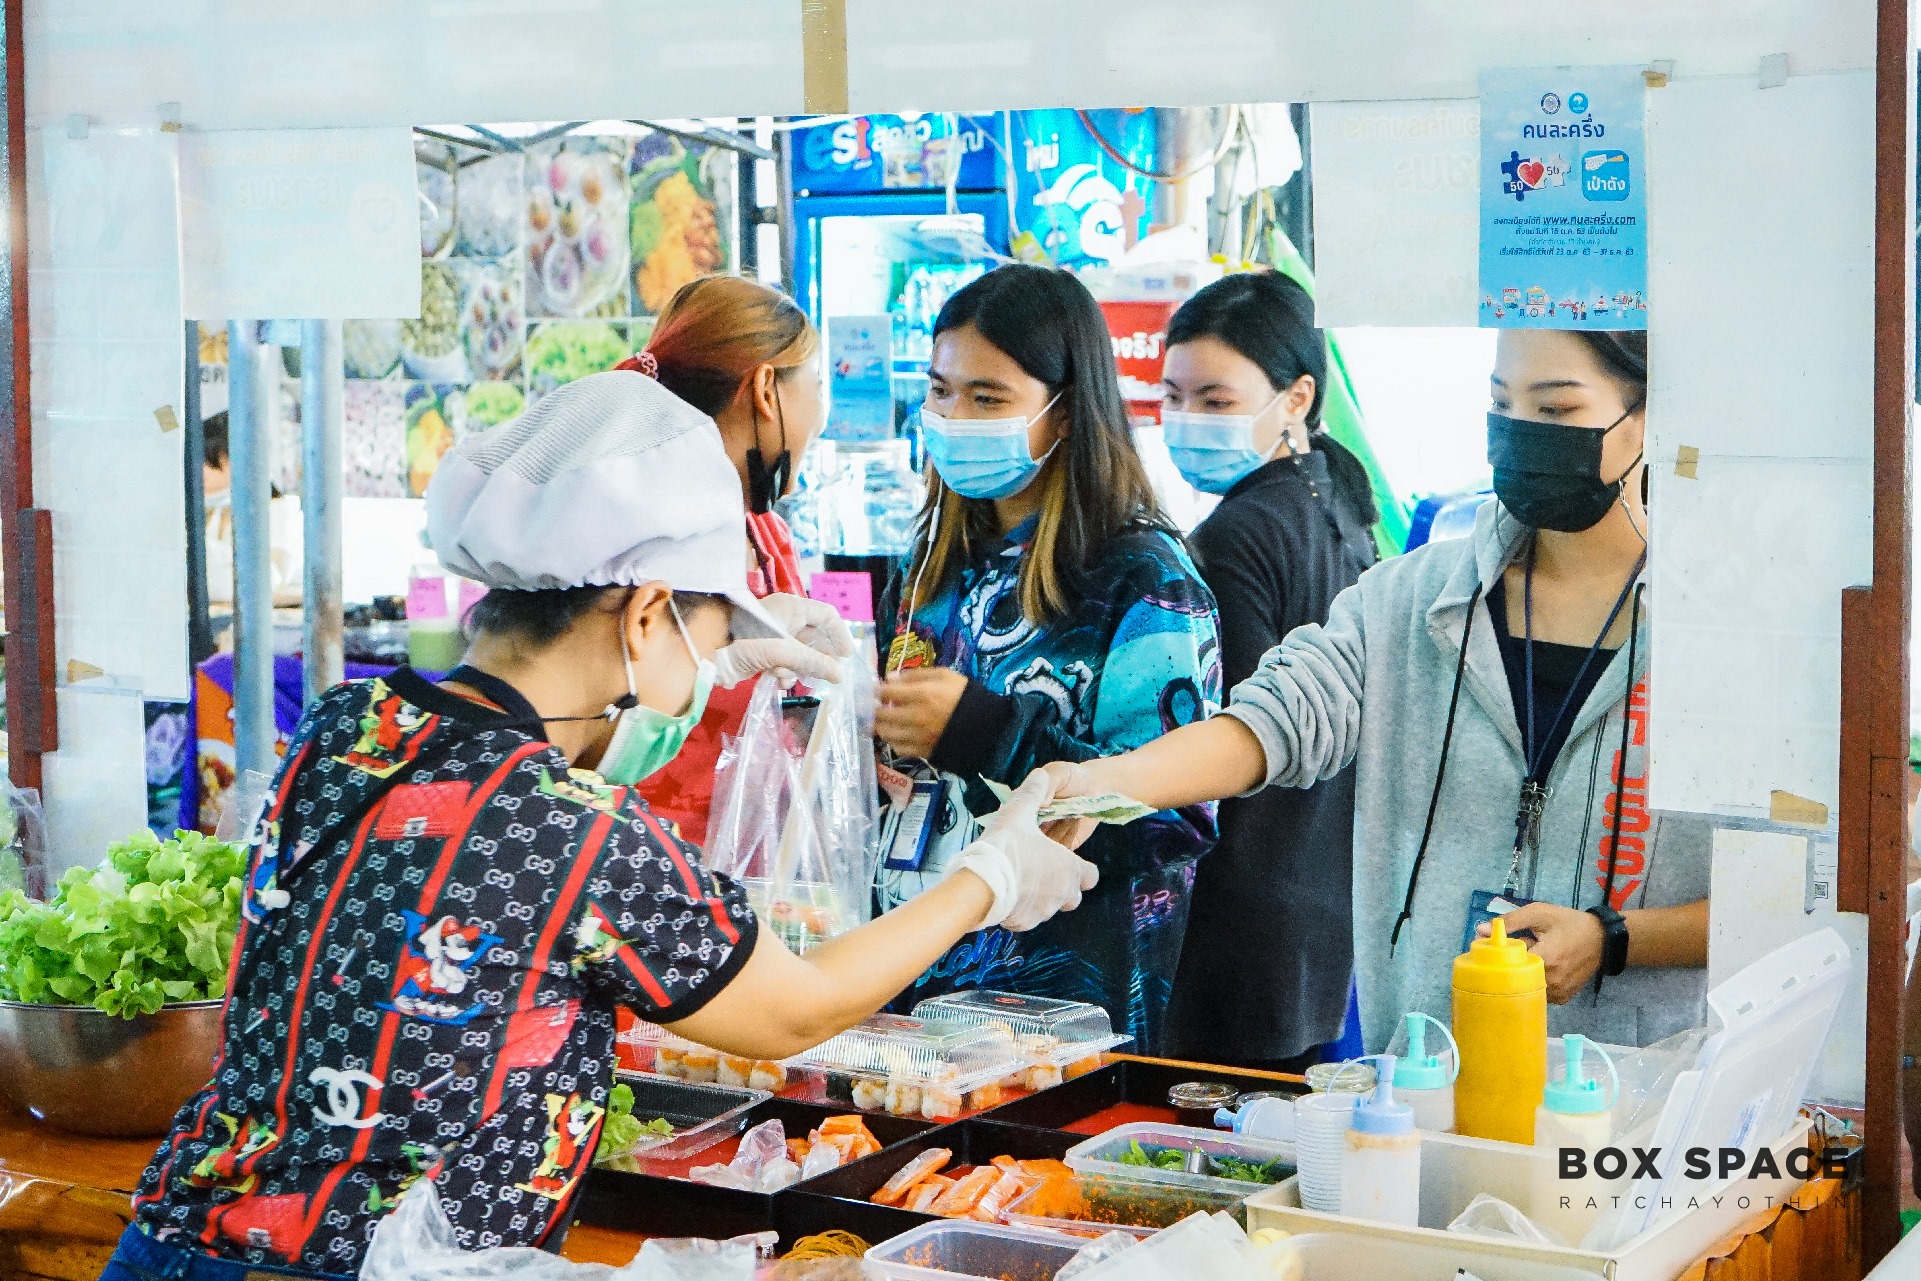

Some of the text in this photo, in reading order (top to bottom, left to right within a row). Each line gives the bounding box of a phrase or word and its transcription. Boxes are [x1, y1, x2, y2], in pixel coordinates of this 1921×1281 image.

[1523, 113, 1605, 139] คนละครึ่ง
[1509, 181, 1524, 192] 50
[1543, 211, 1636, 226] www.คนละครึ่ง.com
[1576, 227, 1586, 235] 63
[1625, 248, 1634, 256] 63
